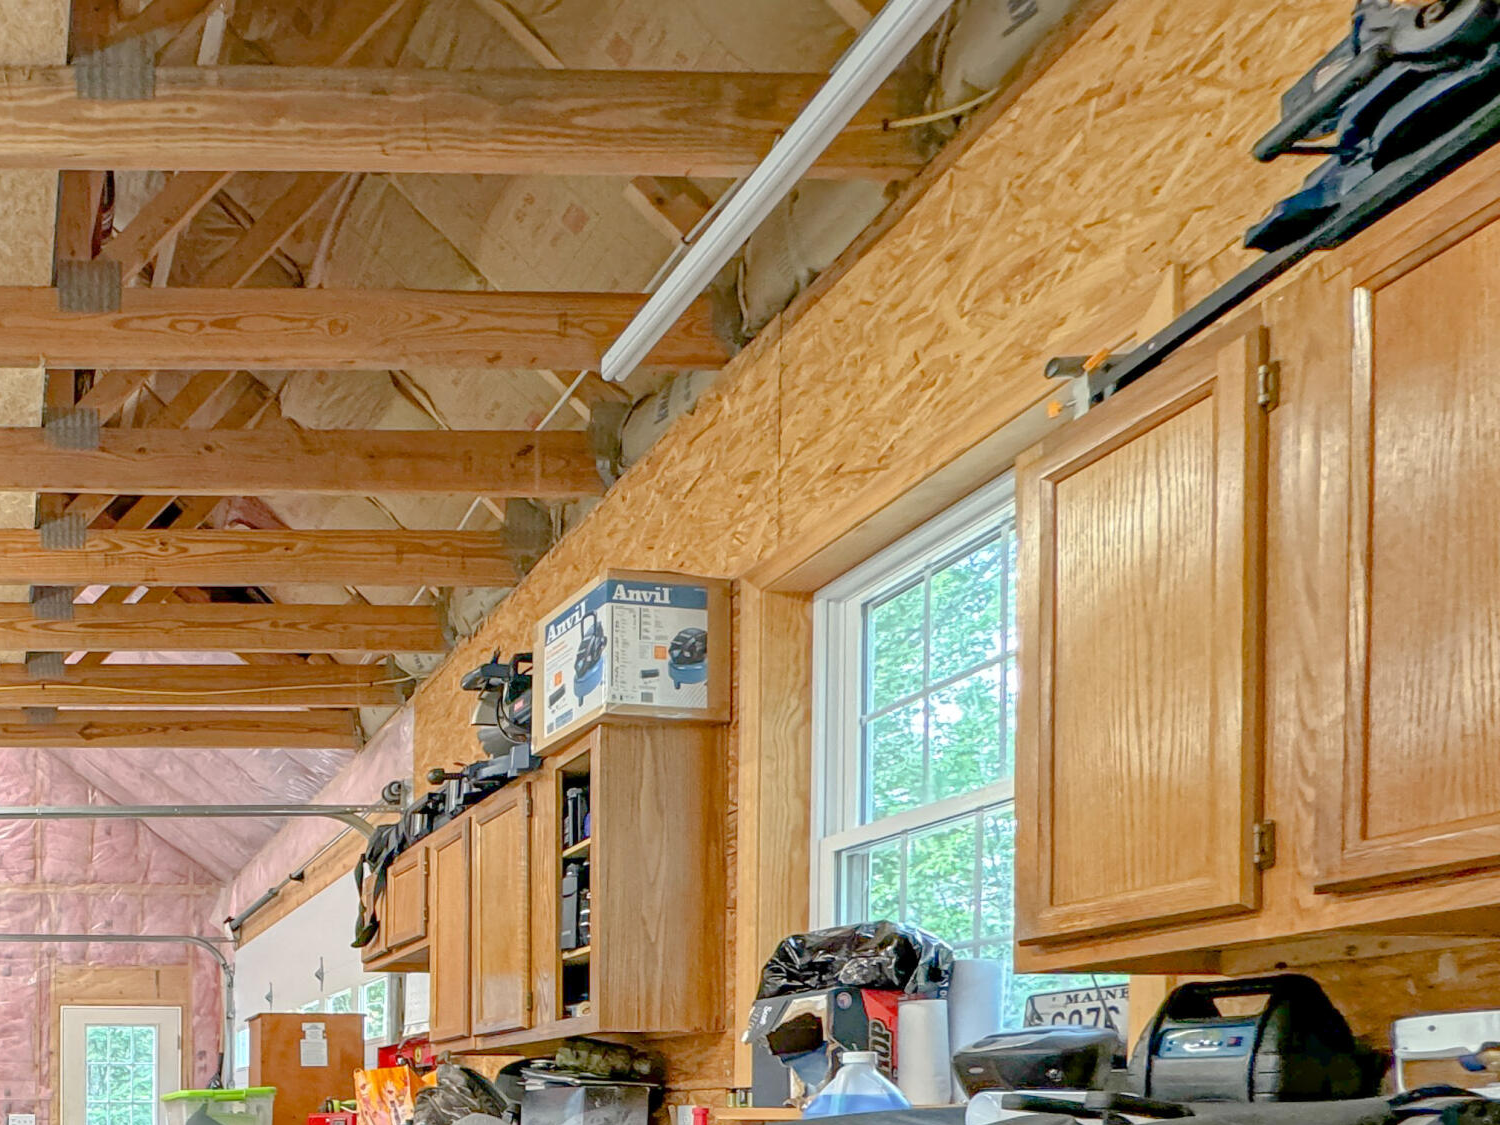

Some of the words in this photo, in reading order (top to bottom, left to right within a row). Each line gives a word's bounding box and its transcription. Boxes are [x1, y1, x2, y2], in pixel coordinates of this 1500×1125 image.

[612, 584, 670, 604] Anvil
[547, 601, 587, 643] Anvil
[1065, 988, 1129, 1004] MAINE
